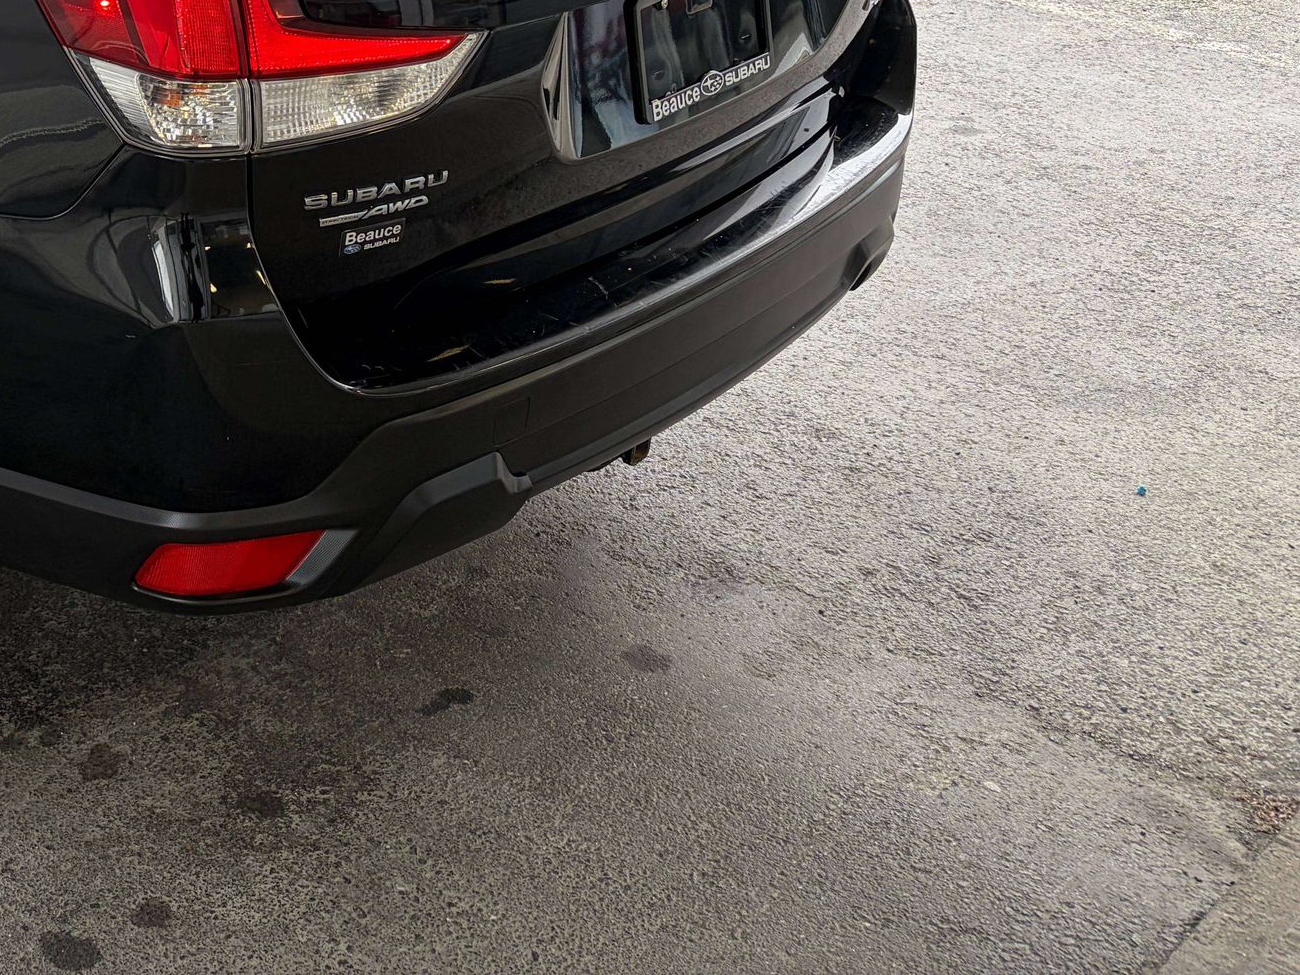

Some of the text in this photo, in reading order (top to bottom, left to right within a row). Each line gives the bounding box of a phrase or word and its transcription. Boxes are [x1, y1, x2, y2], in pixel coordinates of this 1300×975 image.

[652, 55, 771, 122] Beauce SUBARU
[304, 170, 449, 211] SUBARU
[361, 194, 429, 220] AWD
[344, 224, 402, 246] Beauce
[363, 236, 400, 250] SUBARU
